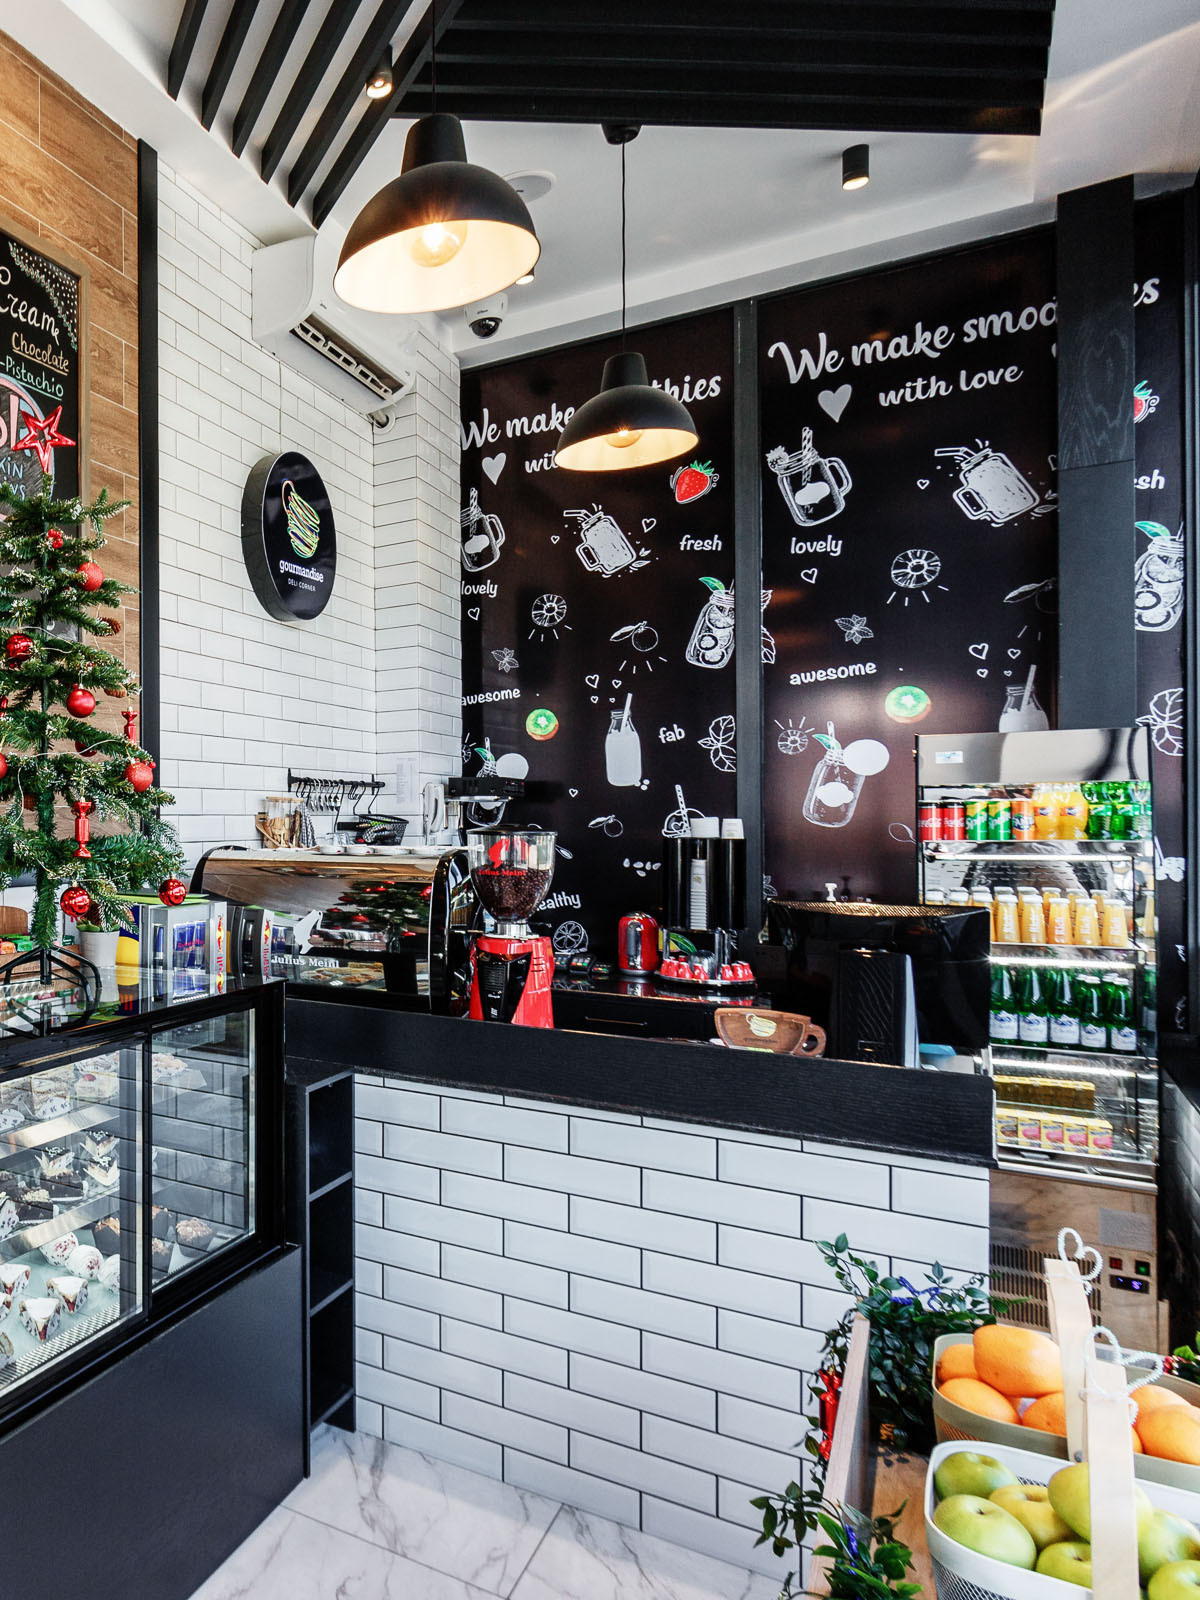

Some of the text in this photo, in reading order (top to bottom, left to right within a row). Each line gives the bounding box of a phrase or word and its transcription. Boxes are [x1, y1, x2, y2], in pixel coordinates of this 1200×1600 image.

[11, 331, 70, 372] Chocolate
[768, 331, 846, 385] We
[851, 321, 956, 368] make
[878, 364, 1025, 407] with love
[460, 408, 502, 451] We
[524, 449, 558, 475] wit
[679, 534, 723, 553] fresh
[790, 534, 843, 558] lovely
[279, 559, 324, 583] gourmandise
[287, 577, 298, 587] DELI
[461, 579, 499, 598] lovely
[788, 660, 878, 686] awesome
[460, 687, 521, 707] awesome
[658, 723, 686, 744] fab
[536, 891, 581, 911] ealthy
[270, 954, 340, 969] Julius Meinl
